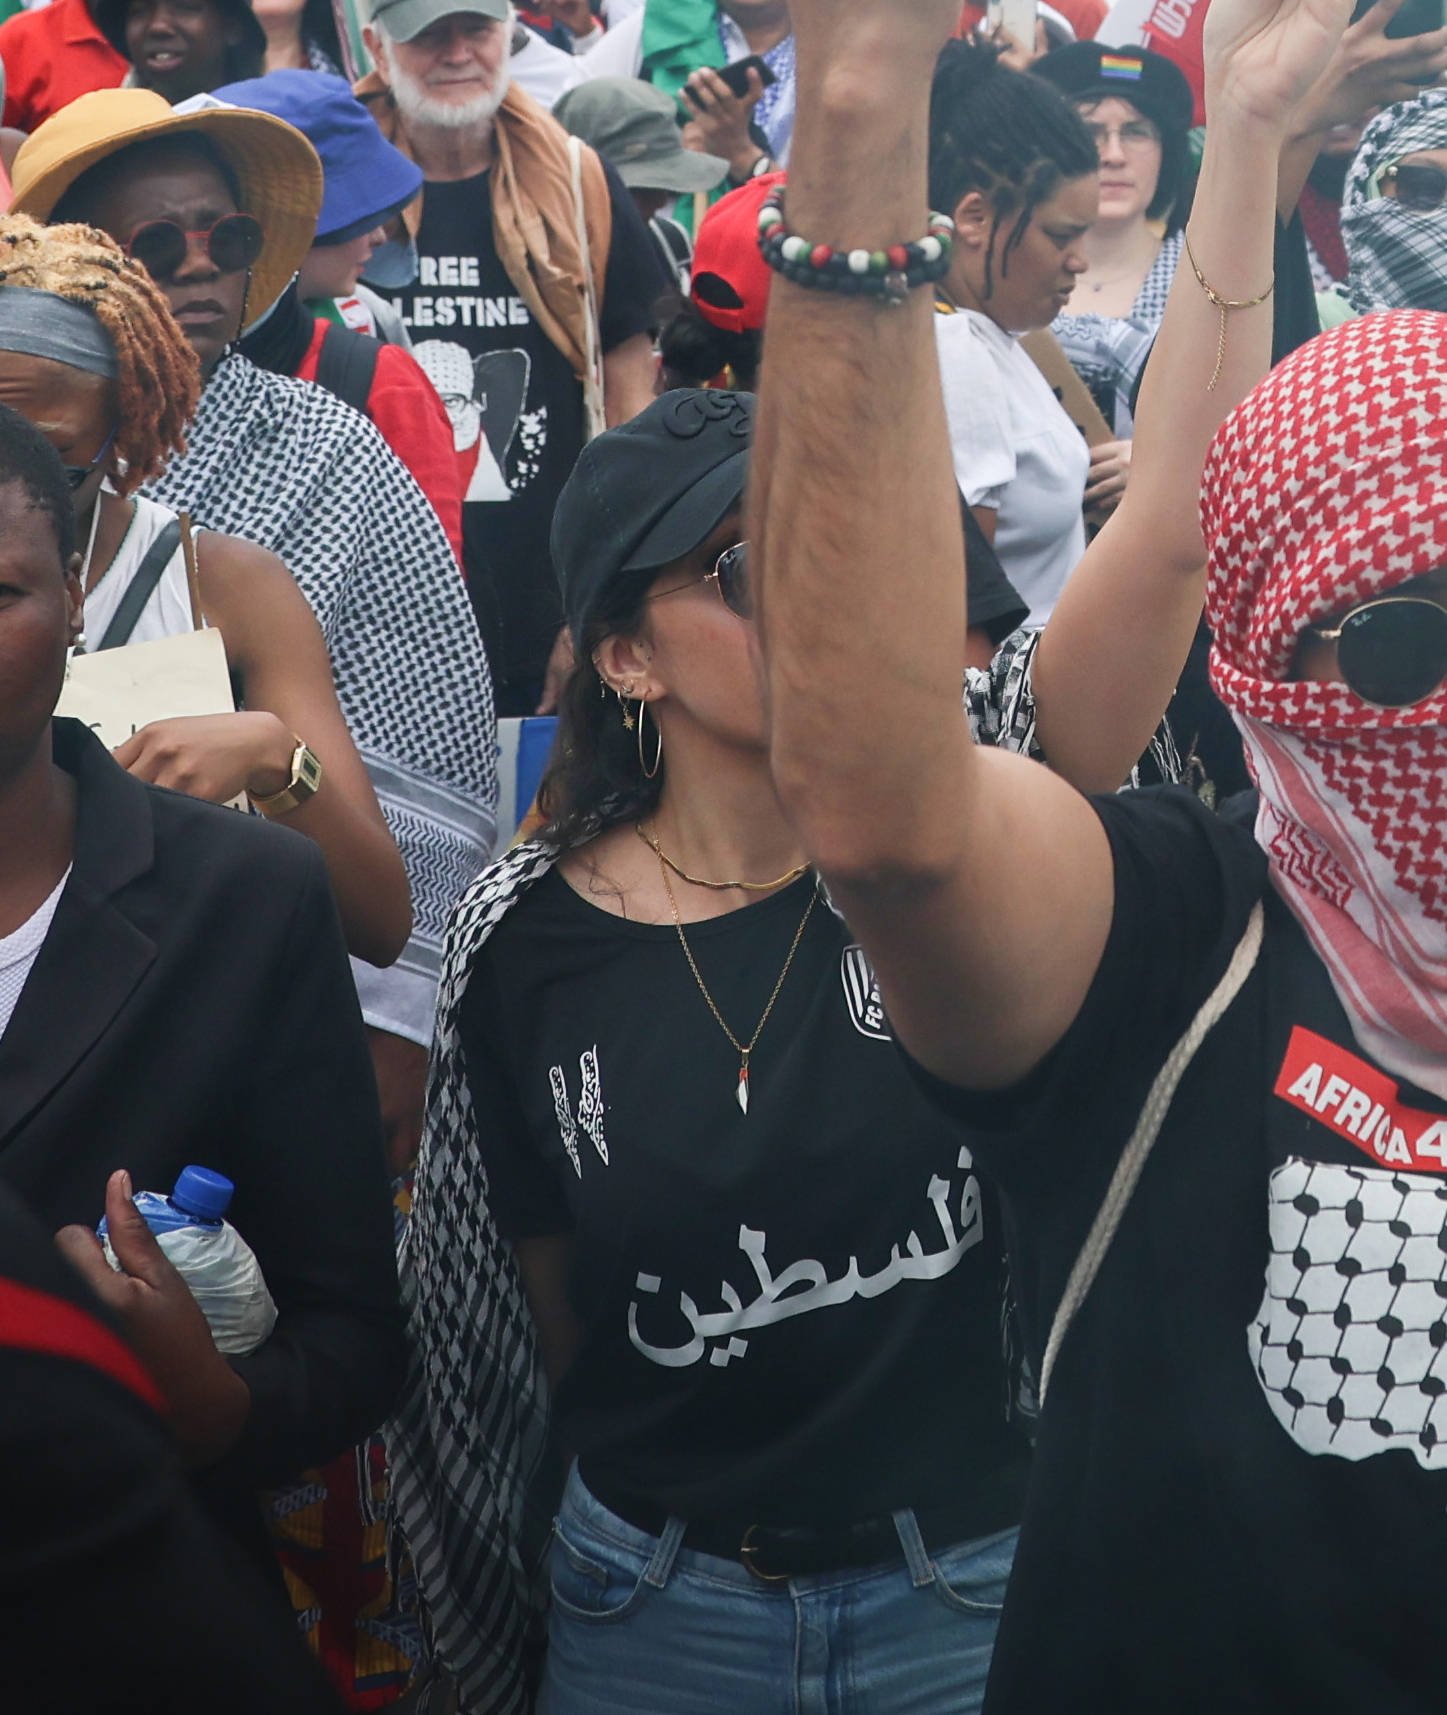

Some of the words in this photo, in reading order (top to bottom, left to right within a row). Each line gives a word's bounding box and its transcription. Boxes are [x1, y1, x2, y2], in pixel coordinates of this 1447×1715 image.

[419, 251, 481, 287] REE
[391, 295, 531, 327] LESTINE
[865, 1005, 884, 1030] FC
[1287, 1062, 1413, 1166] AFRICA
[627, 1145, 984, 1368] فلسطين
